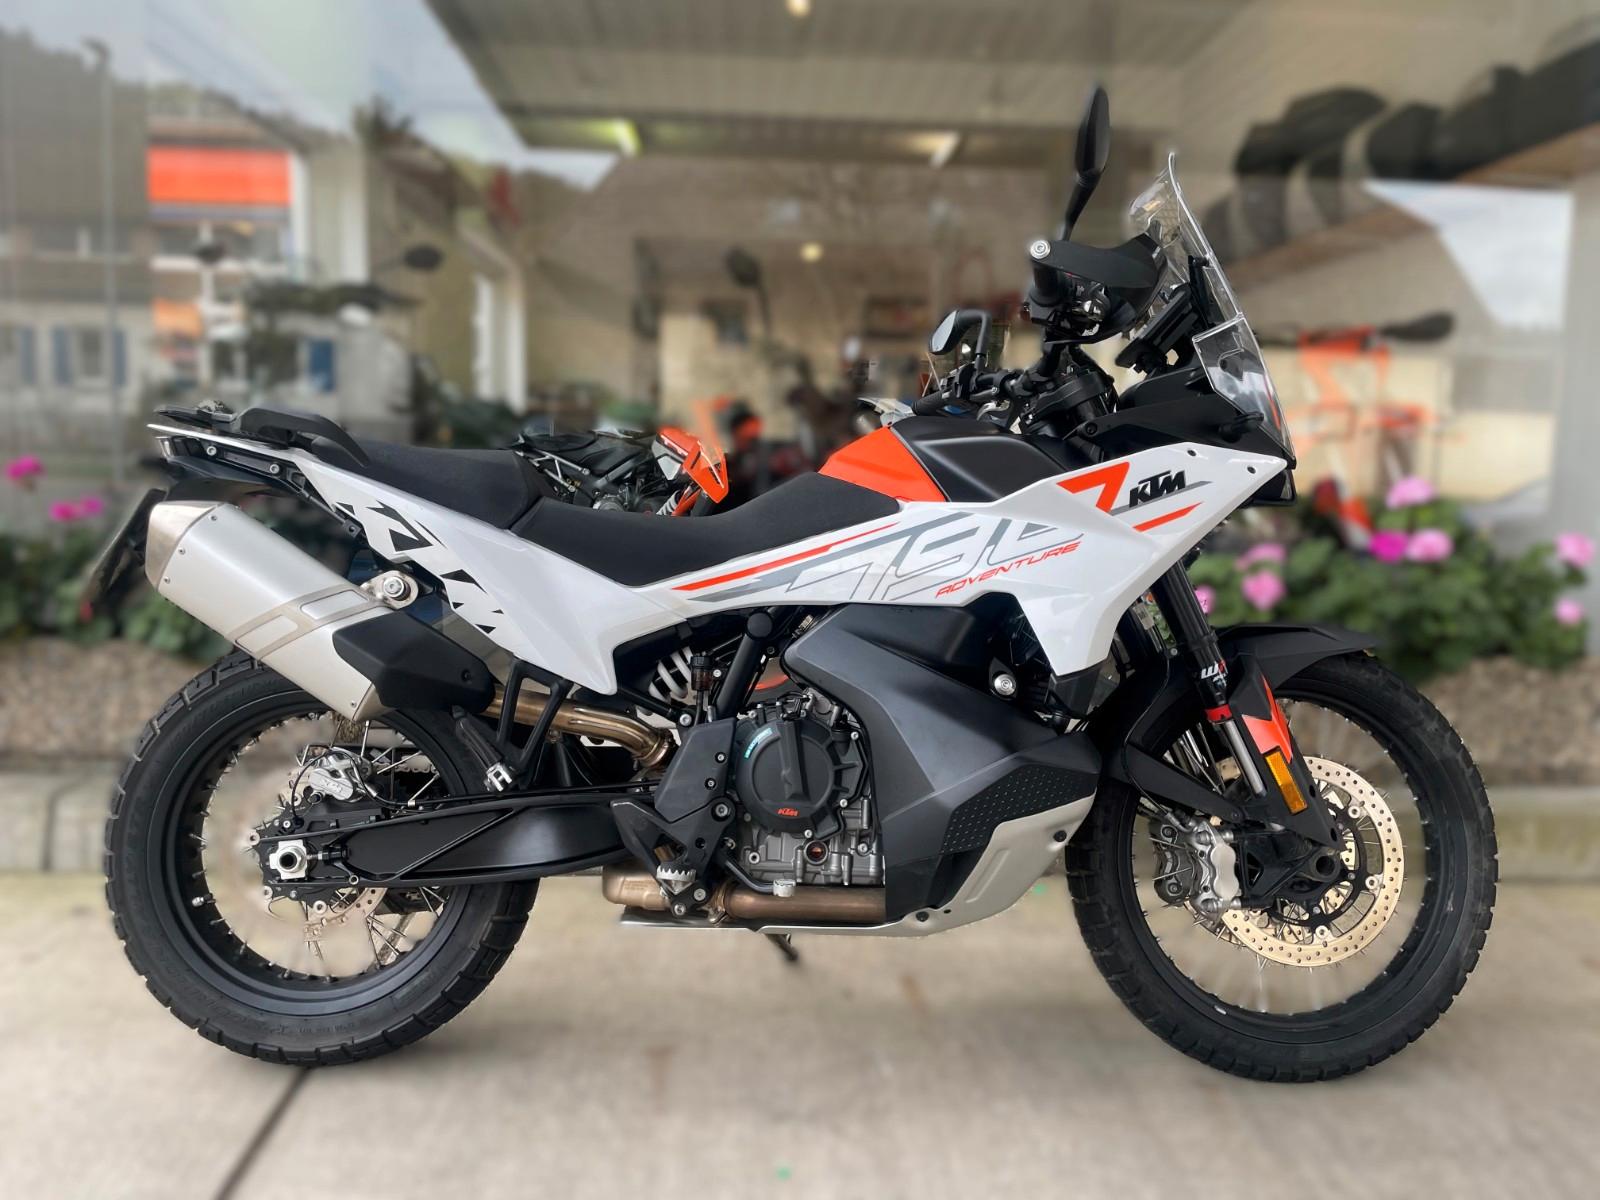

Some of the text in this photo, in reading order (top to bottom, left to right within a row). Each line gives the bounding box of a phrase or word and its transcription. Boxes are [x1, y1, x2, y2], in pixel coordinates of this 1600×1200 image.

[1128, 470, 1186, 508] KTM
[935, 541, 1082, 598] ADVENTURE
[777, 808, 799, 817] KTM
